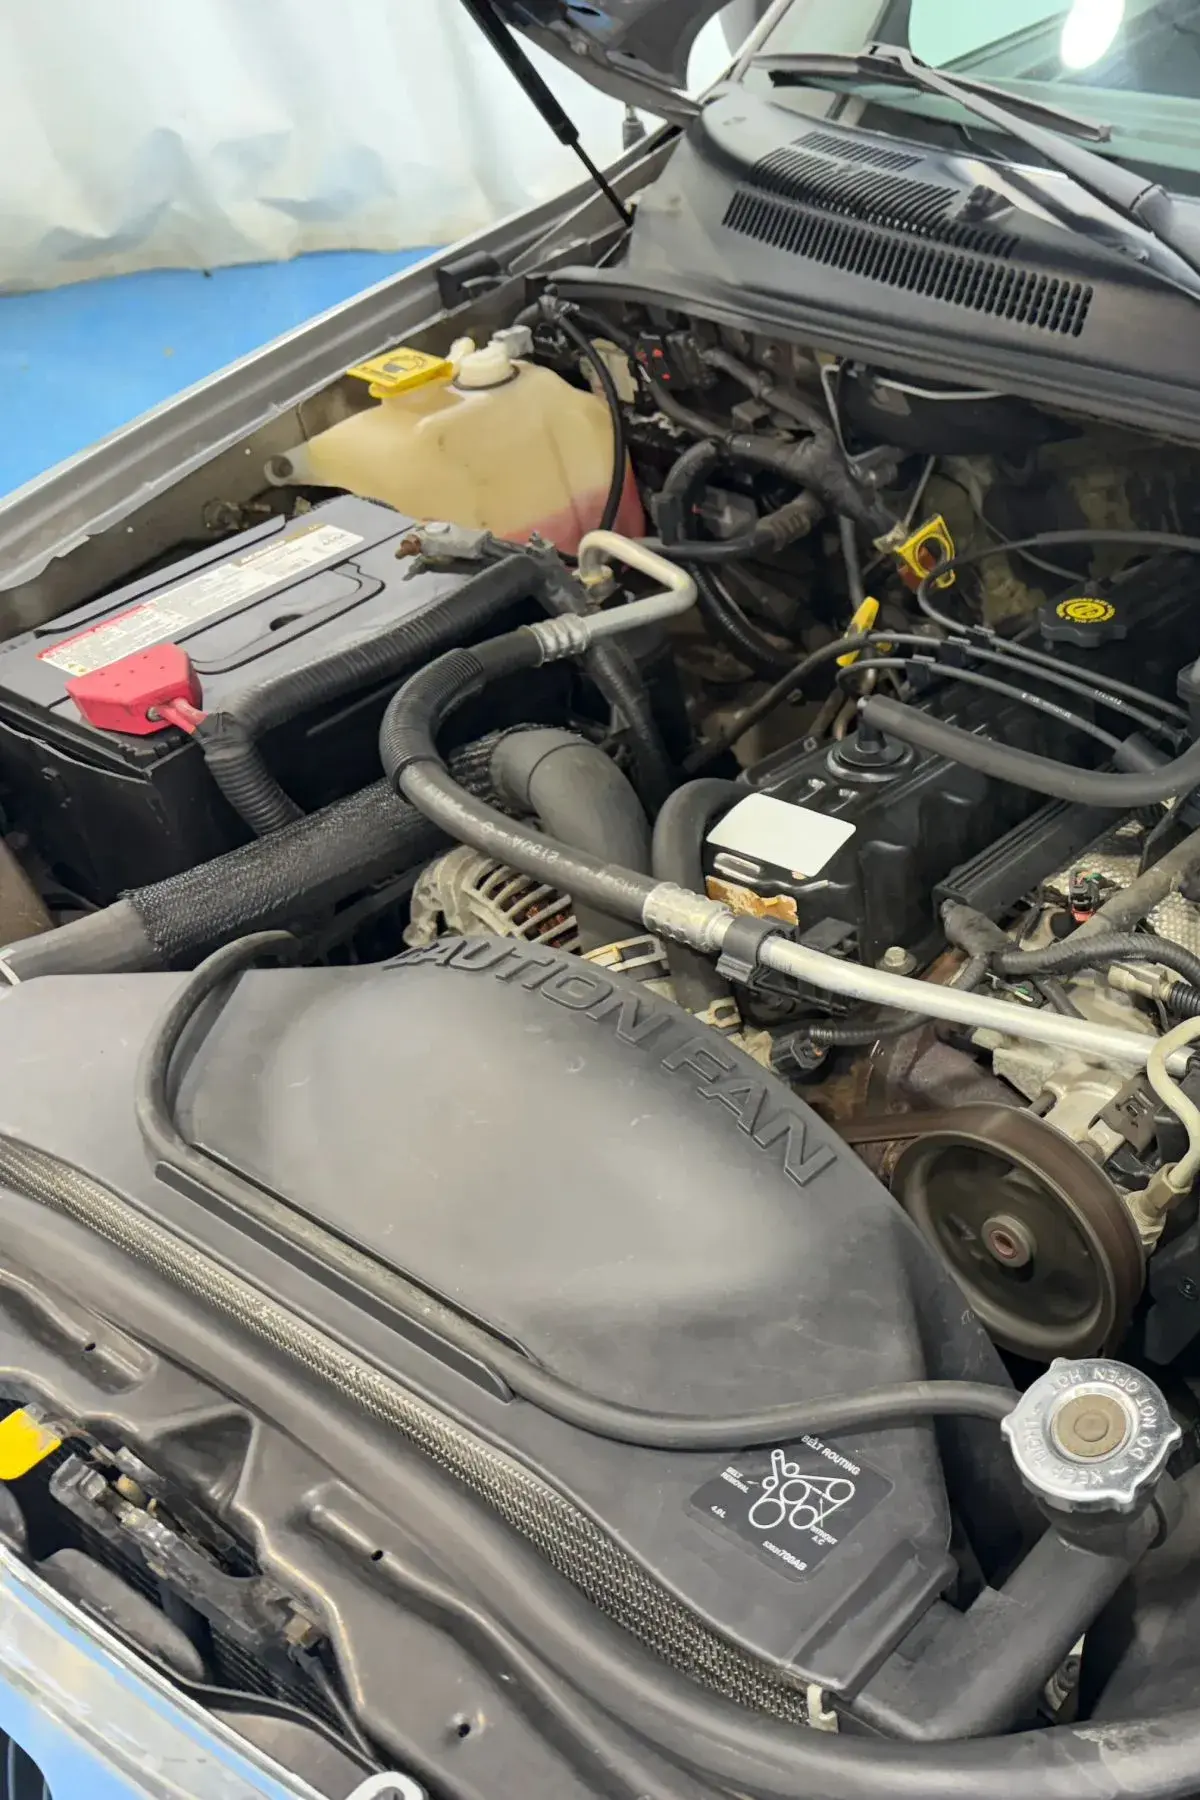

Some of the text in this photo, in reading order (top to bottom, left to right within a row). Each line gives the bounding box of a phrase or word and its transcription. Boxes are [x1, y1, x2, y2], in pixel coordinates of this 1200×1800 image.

[661, 1037, 839, 1187] FAN
[1051, 1367, 1157, 1460] DO NOT OPEN HOT
[801, 1435, 860, 1476] BELT ROUTING
[720, 1472, 749, 1493] REMOVAL
[1052, 1467, 1104, 1485] KEEP
[710, 1505, 726, 1519] 4.0L
